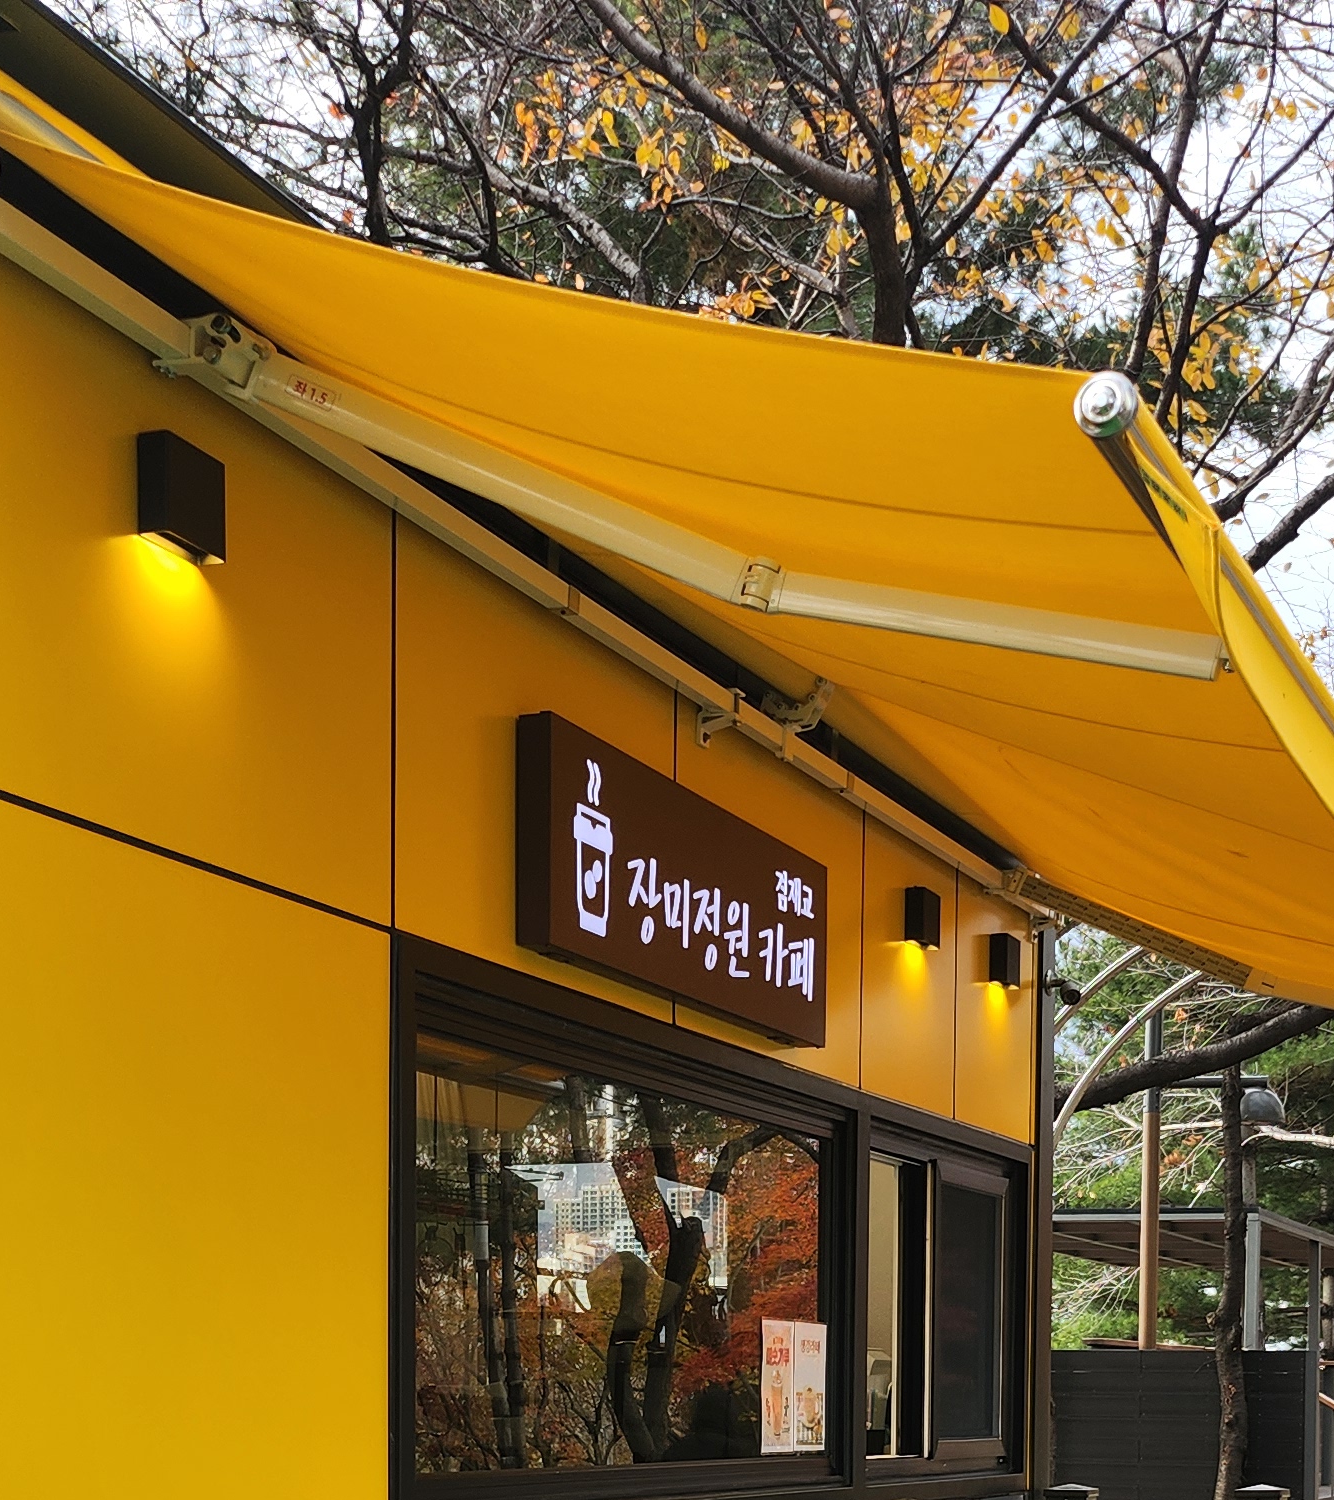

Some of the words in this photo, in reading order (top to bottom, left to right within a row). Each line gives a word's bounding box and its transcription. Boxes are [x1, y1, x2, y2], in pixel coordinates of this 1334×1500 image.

[293, 380, 307, 397] 좌
[310, 387, 328, 404] 1.5
[774, 869, 814, 919] 겸재교
[627, 857, 750, 978] 장미정원
[758, 923, 815, 1002] 카페
